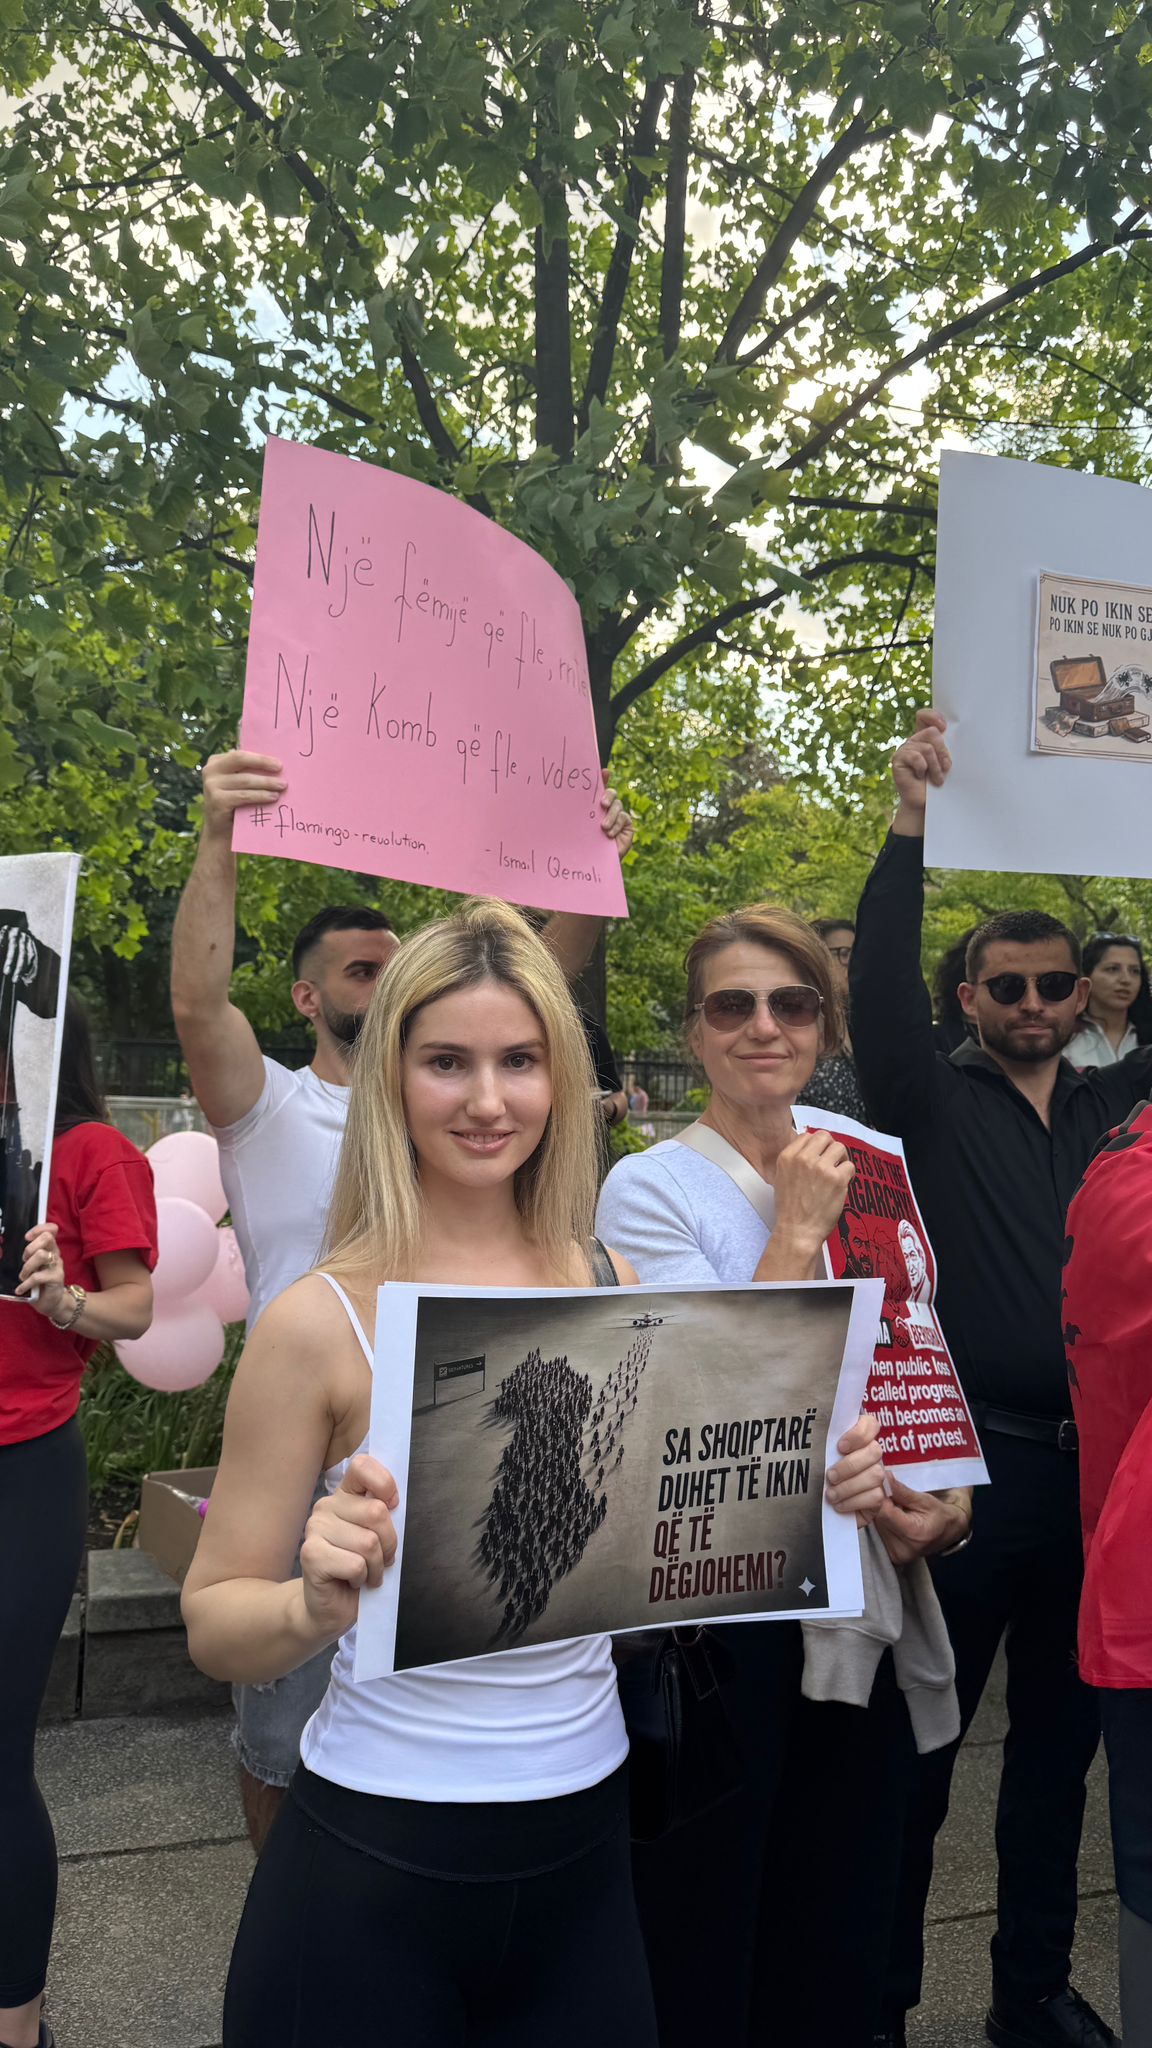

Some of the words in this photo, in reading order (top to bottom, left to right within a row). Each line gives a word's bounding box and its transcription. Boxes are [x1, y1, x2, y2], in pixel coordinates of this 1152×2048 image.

[306, 503, 375, 618] Një
[394, 541, 469, 647] fëmijë
[483, 610, 505, 669] që
[1049, 616, 1061, 632] PO
[1063, 619, 1084, 634] IKIN
[1087, 621, 1099, 636] SE
[1102, 623, 1122, 638] NUK
[1125, 625, 1137, 640] PO
[1050, 594, 1076, 615] NUK
[1081, 598, 1099, 617] PO
[1105, 601, 1133, 621] IKIN
[1137, 606, 1152, 623] SE
[275, 652, 340, 757] Një
[456, 723, 481, 784] që
[883, 1160, 908, 1189] THE
[845, 1176, 919, 1227] IGARCHY!
[871, 1360, 894, 1377] hen
[895, 1356, 932, 1381] public
[931, 1356, 951, 1377] loss
[870, 1380, 908, 1401] called
[908, 1383, 961, 1405] progress,
[894, 1405, 957, 1426] becomes
[954, 1407, 967, 1423] an
[662, 1426, 691, 1466] SA
[698, 1407, 817, 1462] SHQIPTARË
[878, 1432, 900, 1453] act
[900, 1429, 916, 1451] of
[917, 1426, 968, 1454] protest.
[658, 1466, 731, 1513] DUHET
[736, 1455, 762, 1501] TË
[765, 1457, 810, 1498] IKIN
[653, 1510, 684, 1559] QË
[688, 1506, 715, 1552] TË
[648, 1550, 787, 1604] DËGJOHEMI?
